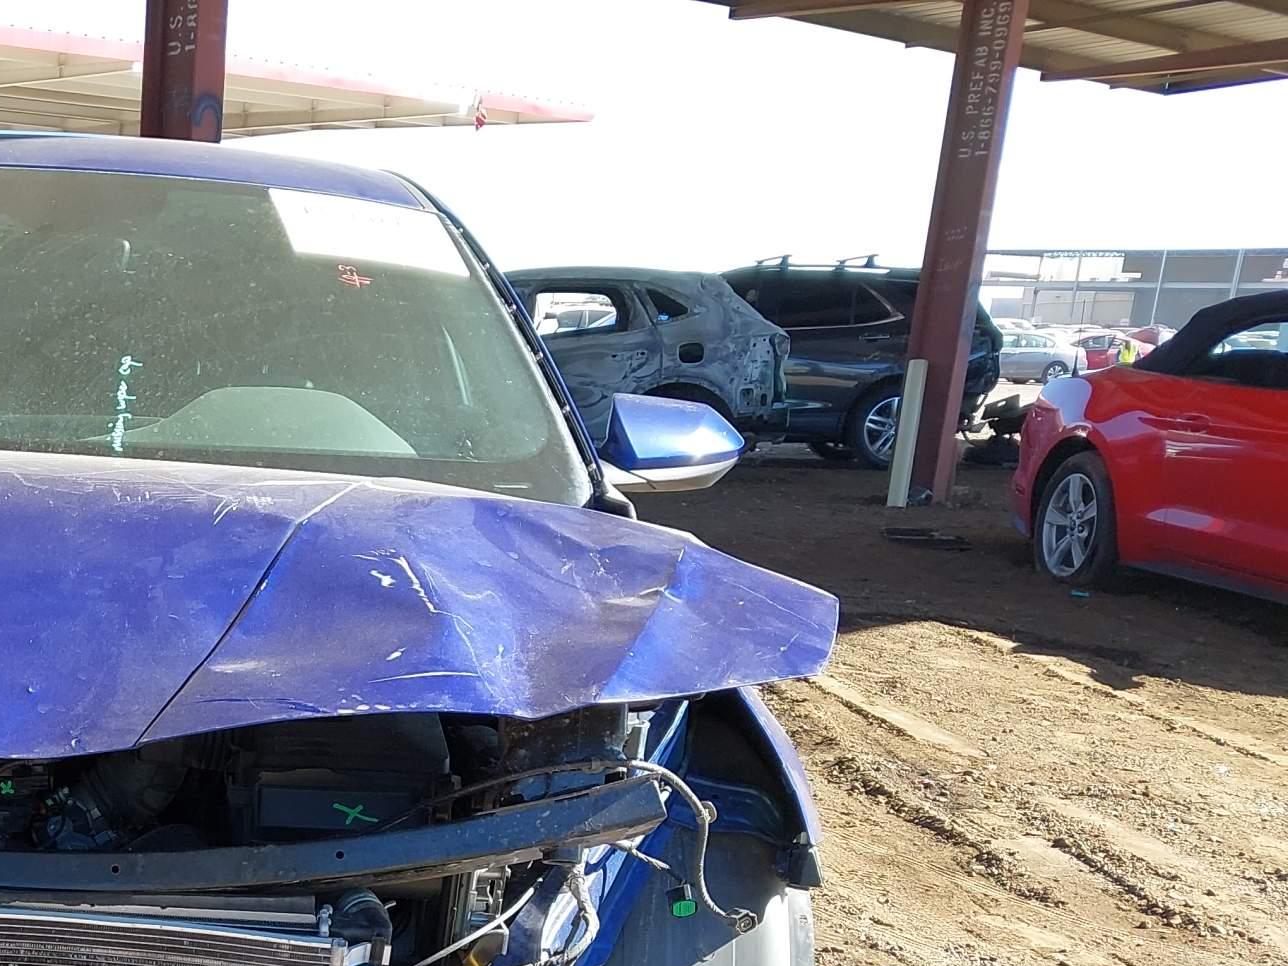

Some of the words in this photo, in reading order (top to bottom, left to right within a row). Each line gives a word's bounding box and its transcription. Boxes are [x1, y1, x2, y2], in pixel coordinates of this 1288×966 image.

[978, 1, 998, 36] INC.
[966, 45, 990, 115] PREFAB
[974, 1, 1012, 157] 1-866-799-0969
[958, 124, 977, 158] U.S.
